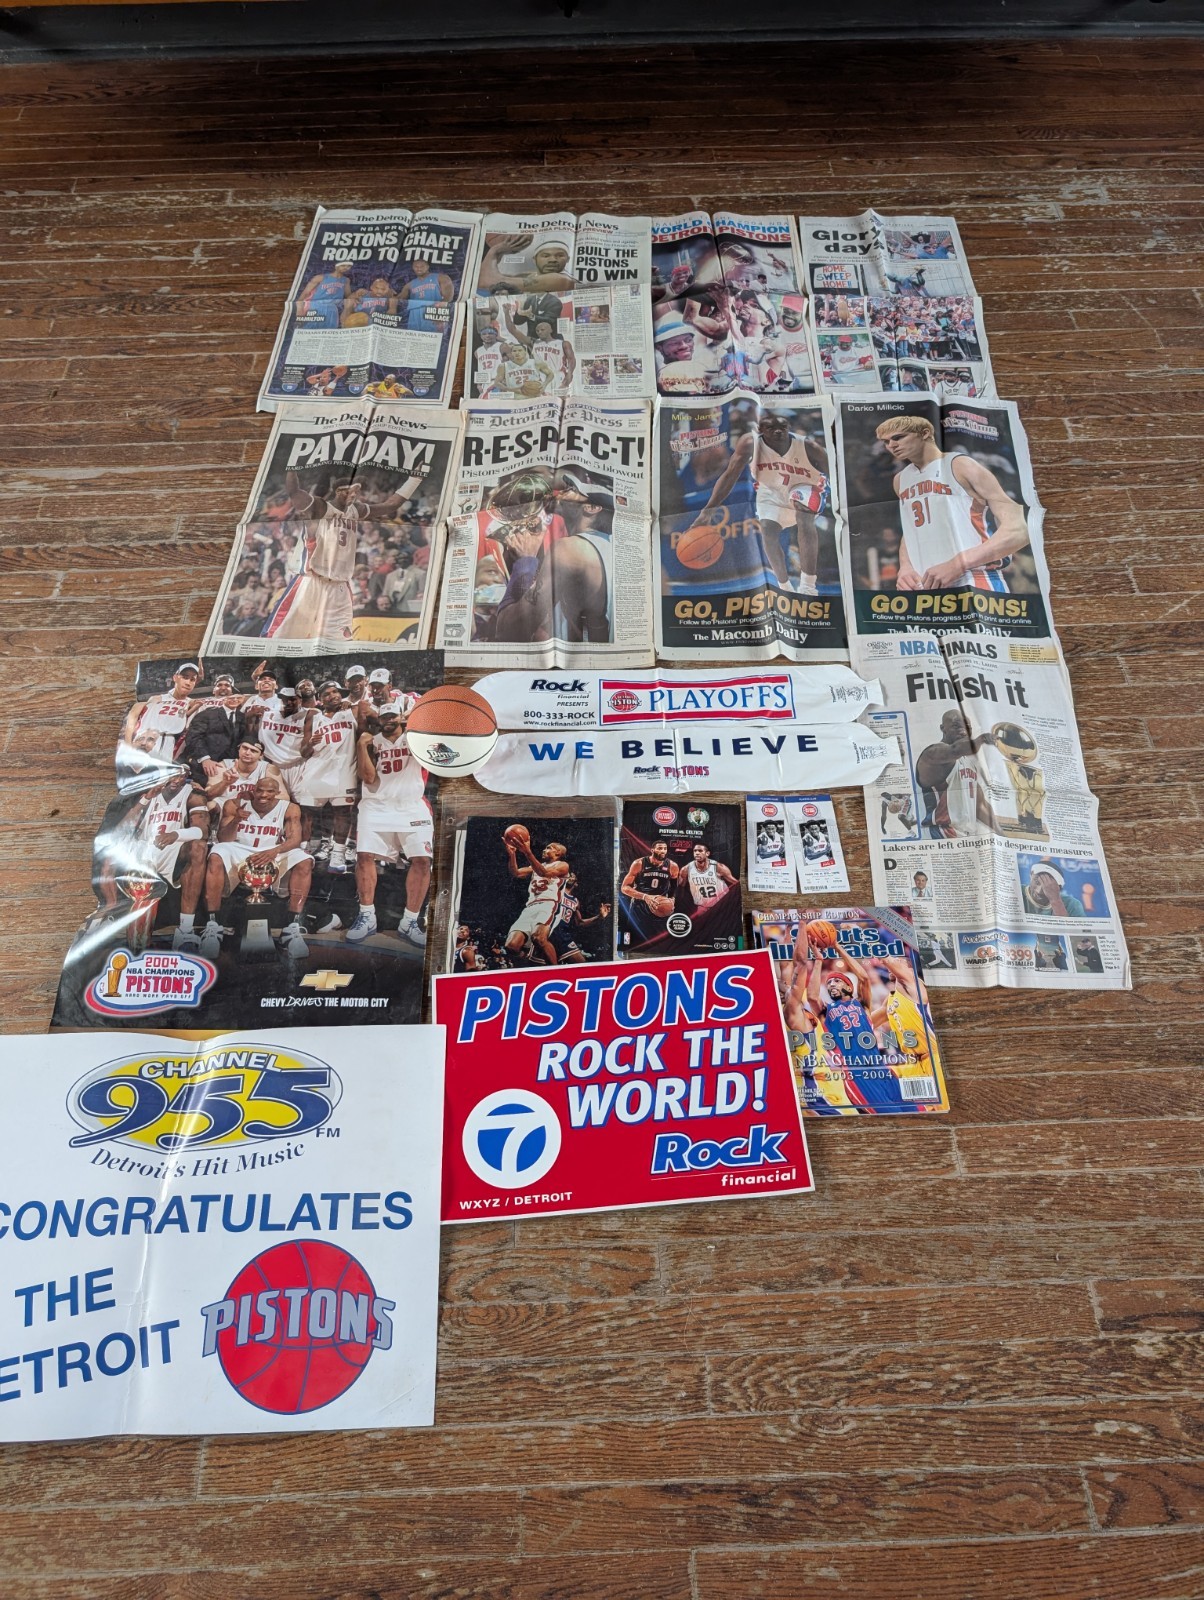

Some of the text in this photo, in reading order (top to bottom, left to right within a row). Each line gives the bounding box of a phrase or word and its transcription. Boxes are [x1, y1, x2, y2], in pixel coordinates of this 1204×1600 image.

[516, 219, 619, 230] The News
[321, 230, 463, 250] PISTONS CHART
[718, 226, 792, 242] PISTONS
[812, 226, 881, 241] Glory
[322, 246, 454, 265] ROAD TO TITLE
[577, 246, 639, 258] BUILT THE
[576, 256, 630, 268] PISTONS
[822, 265, 846, 273] HOME
[576, 267, 639, 283] TO WIN
[816, 272, 853, 281] SWEEP
[424, 313, 450, 322] WALLACE
[438, 307, 450, 315] BEN
[847, 402, 905, 412] Darko Milicic
[313, 416, 338, 425] The
[388, 415, 428, 430] News
[489, 408, 623, 428] Detroit Fee Press
[286, 432, 436, 473] PAYDAY!
[395, 466, 409, 475] NBA
[410, 469, 428, 478] TITLE
[462, 453, 645, 480] Pistons earn it Game 5 blowout
[757, 461, 812, 479] PISTONS
[778, 472, 791, 486] 7
[912, 497, 931, 528] 31
[338, 531, 347, 547] 3
[675, 589, 832, 620] GO, PISTONS!
[871, 592, 1028, 617] GO PISTONS!
[739, 614, 767, 625] progress
[784, 616, 797, 625] print
[907, 614, 931, 622] Pistons
[932, 615, 962, 623] progress
[963, 612, 979, 621] both
[693, 620, 809, 644] The Macomb Daily
[975, 623, 1013, 638] Daily
[899, 639, 939, 656] NBA
[939, 639, 998, 660] INALS
[529, 678, 590, 693] Rock
[905, 671, 999, 703] Finish
[1004, 678, 1029, 708] it
[607, 698, 643, 708] PISTONS
[649, 684, 788, 712] PLAYOFFS
[160, 706, 176, 716] 22
[523, 710, 595, 720] 800-333-ROCK
[262, 720, 302, 735] PISTONS
[313, 720, 353, 736] PISTONS
[275, 733, 284, 744] 7
[324, 731, 342, 744] 10
[528, 734, 819, 761] WE BELIEVE
[382, 758, 403, 774] 30
[633, 766, 660, 774] Rock
[663, 765, 710, 779] PISTONS
[238, 822, 282, 838] PISTONS
[254, 837, 260, 847] 1
[882, 836, 1094, 858] Lakers are left clinging desperate measures
[530, 879, 549, 895] 33
[651, 878, 659, 889] 0
[692, 876, 717, 885] CELTICS
[699, 886, 717, 898] 42
[757, 910, 860, 921] CHAMPIONSHIP EDITION
[966, 957, 988, 966] WARD
[1006, 947, 1033, 961] $399
[145, 957, 178, 968] 2004
[145, 968, 195, 976] CHAMPIONS
[126, 975, 195, 994] PISTONS
[261, 994, 389, 1008] CHEVY DRIVES THE MOTOR CITY
[456, 963, 755, 1044] PISTONS
[840, 1012, 861, 1031] 32
[788, 1030, 919, 1051] PISTONS
[535, 1023, 768, 1082] ROCK THE
[796, 1052, 918, 1069] NBA CHAMPIONS
[141, 1051, 283, 1080] CHANNEL
[567, 1067, 769, 1129] WORLD!
[315, 1127, 342, 1138] FM
[468, 1105, 556, 1188] 7
[651, 1124, 790, 1176] Rock
[90, 1141, 306, 1181] Detroit's Hit Music
[721, 1168, 797, 1188] financial
[459, 1191, 573, 1210] WXYZ DETROIT
[14, 1266, 117, 1328] THE
[201, 1286, 397, 1359] PISTONS
